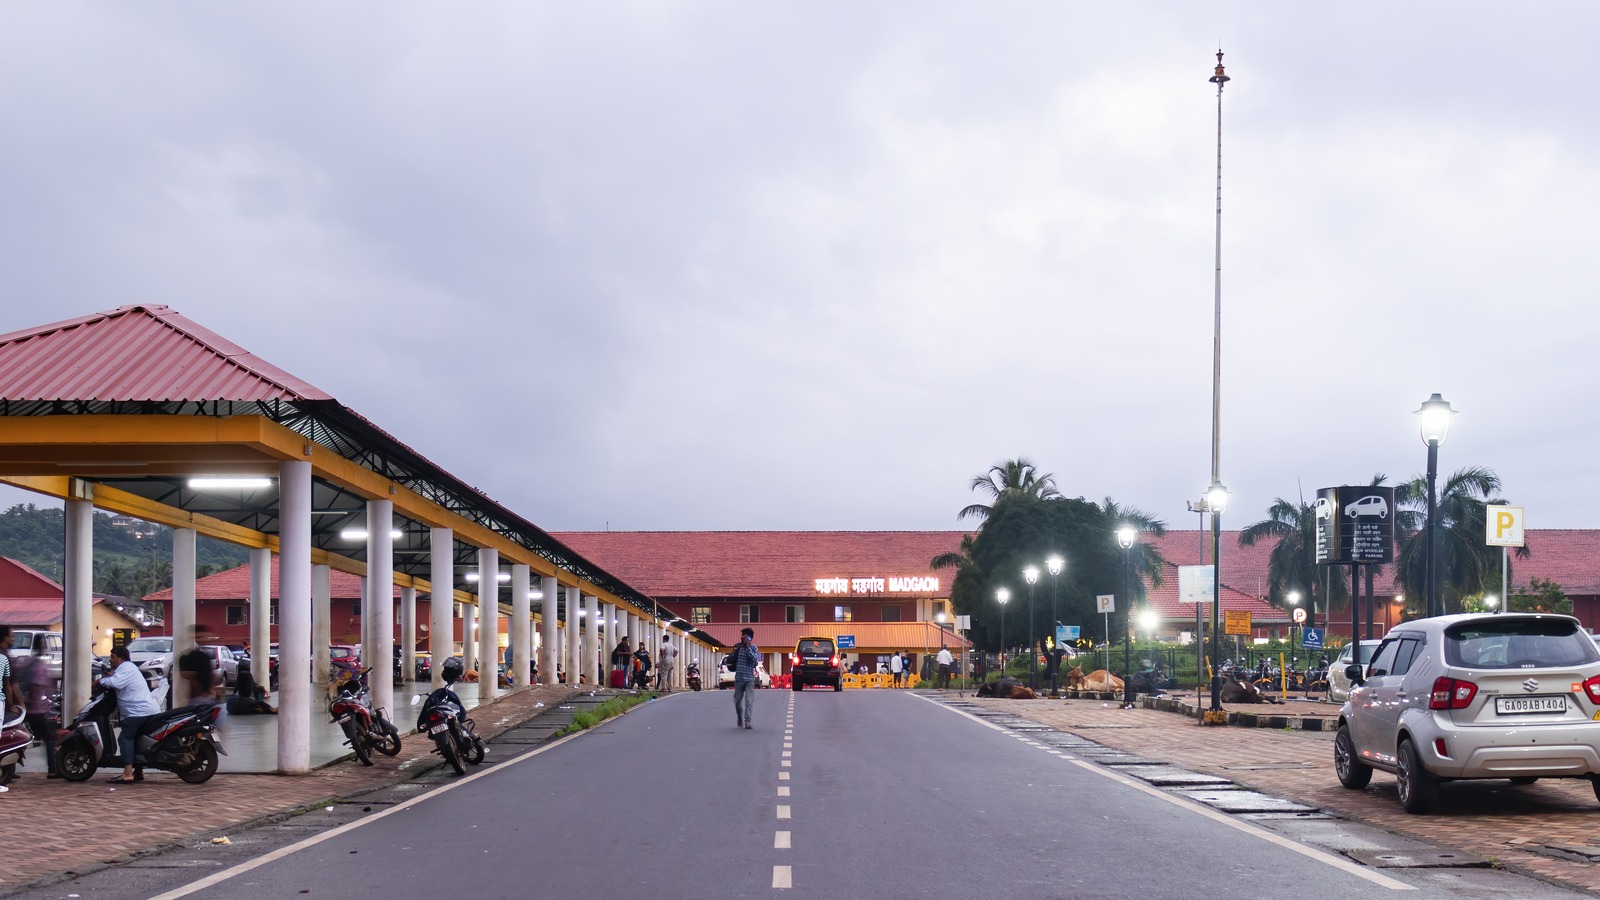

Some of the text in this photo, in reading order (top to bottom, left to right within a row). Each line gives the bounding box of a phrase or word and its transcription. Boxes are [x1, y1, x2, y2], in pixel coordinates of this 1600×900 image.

[1497, 512, 1514, 538] P
[888, 576, 939, 591] MADGAON
[1102, 598, 1109, 609] P
[1504, 699, 1564, 710] GA08AB1404
